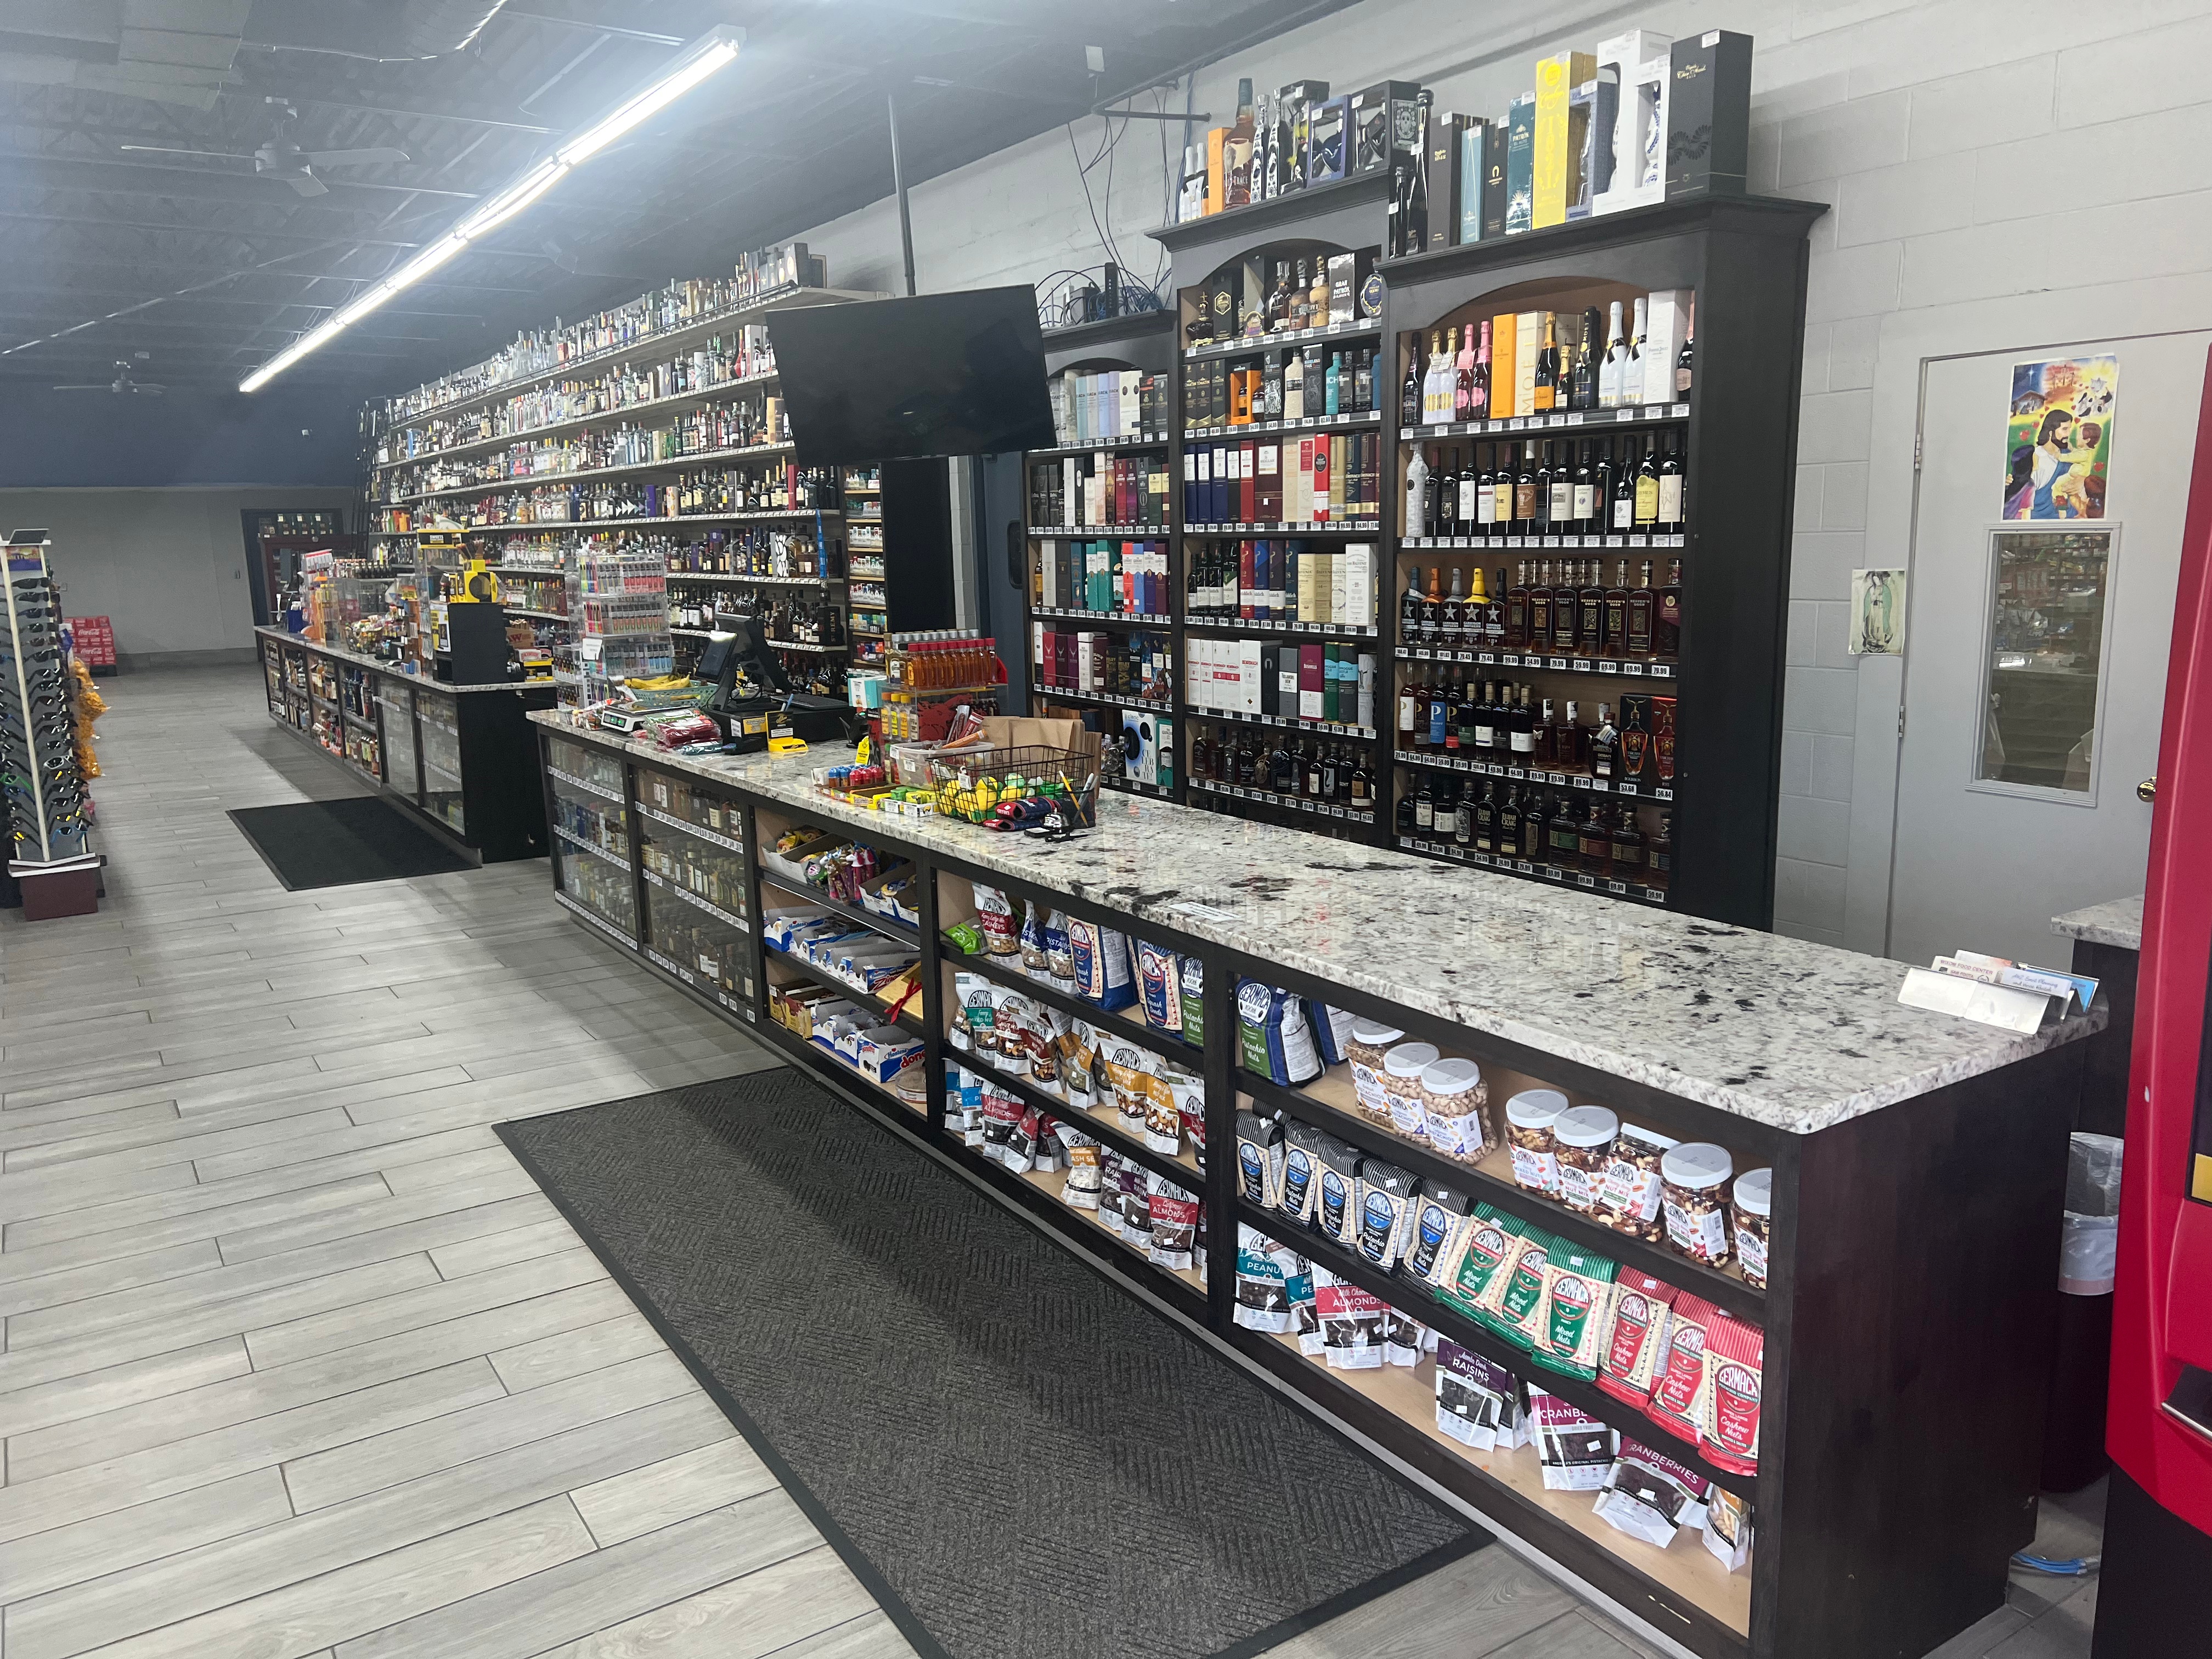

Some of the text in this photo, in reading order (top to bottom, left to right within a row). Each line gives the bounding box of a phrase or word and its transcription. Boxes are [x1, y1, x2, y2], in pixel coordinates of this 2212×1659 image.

[871, 973, 902, 991] Zing
[1367, 1242, 1378, 1251] Nuts
[1247, 1262, 1280, 1273] PEANU
[1333, 1296, 1381, 1307] ALMONDS
[1452, 1357, 1489, 1381] RAISINS
[1719, 1367, 1758, 1397] GERMACK
[1668, 1386, 1684, 1399] Nuts
[1541, 1408, 1588, 1419] CRANBE
[1721, 1416, 1749, 1434] Cashew
[1725, 1427, 1742, 1440] Nuts
